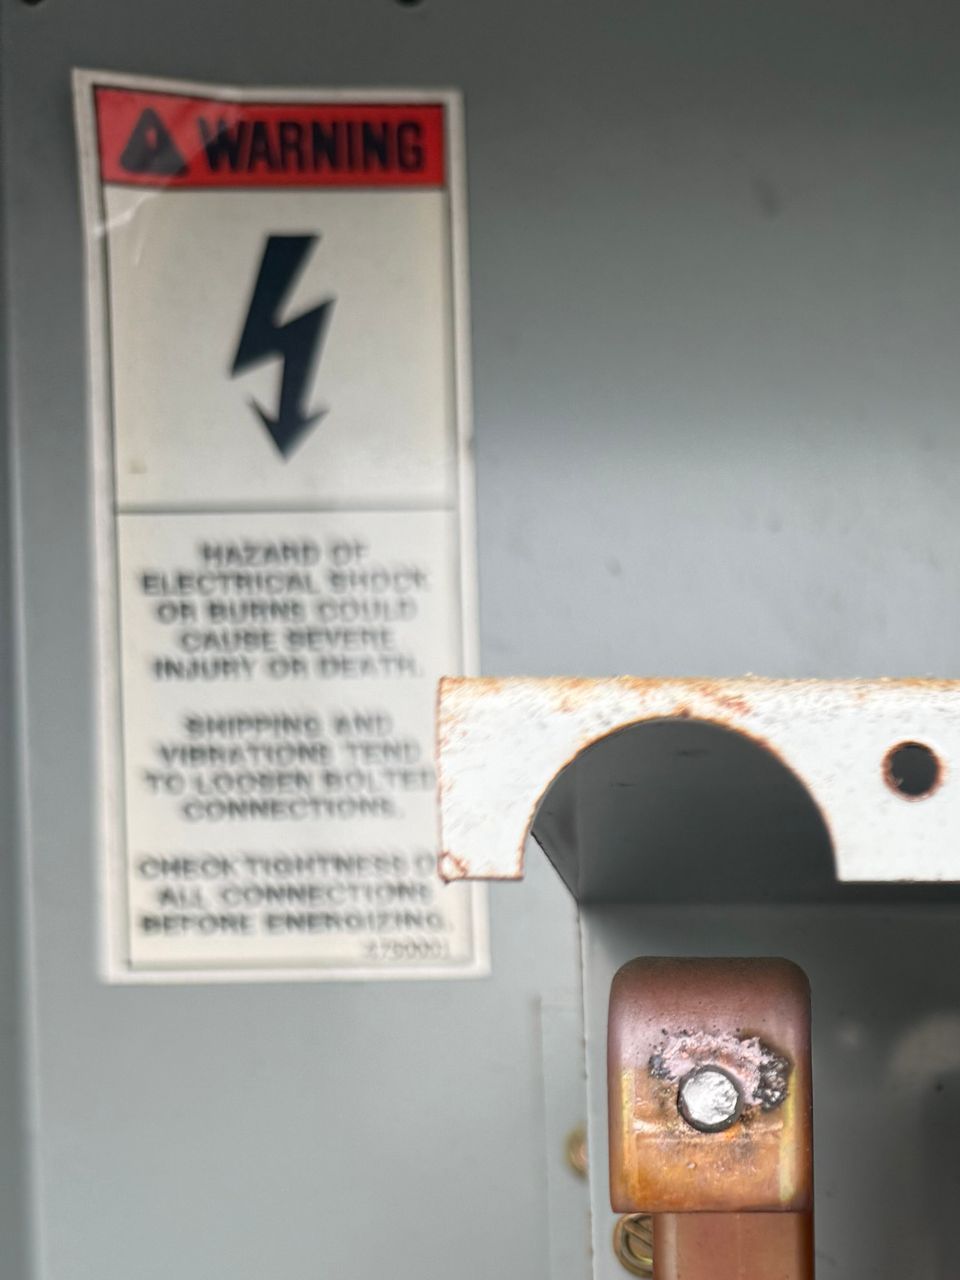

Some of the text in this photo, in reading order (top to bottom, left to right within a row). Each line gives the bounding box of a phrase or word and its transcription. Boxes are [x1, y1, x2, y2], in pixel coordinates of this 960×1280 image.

[199, 116, 427, 173] WARNING
[201, 541, 367, 566] HAZARD OF
[141, 567, 428, 596] ELECTRICAL SHOCK
[156, 598, 418, 624] OR BURNS COULD
[181, 627, 394, 652] CAUSE SEVERE
[154, 656, 256, 681] INJURY
[267, 656, 308, 680] OR
[185, 713, 393, 738] SHIPPING AND
[159, 742, 421, 767] VIBRATIONS TEND
[146, 772, 185, 796] TO
[197, 770, 313, 795] LOOSEN
[139, 853, 437, 879] CHECK TIGHTNESS O
[158, 881, 433, 908] ALL CONNECTIONS
[142, 912, 254, 936] BEFORE
